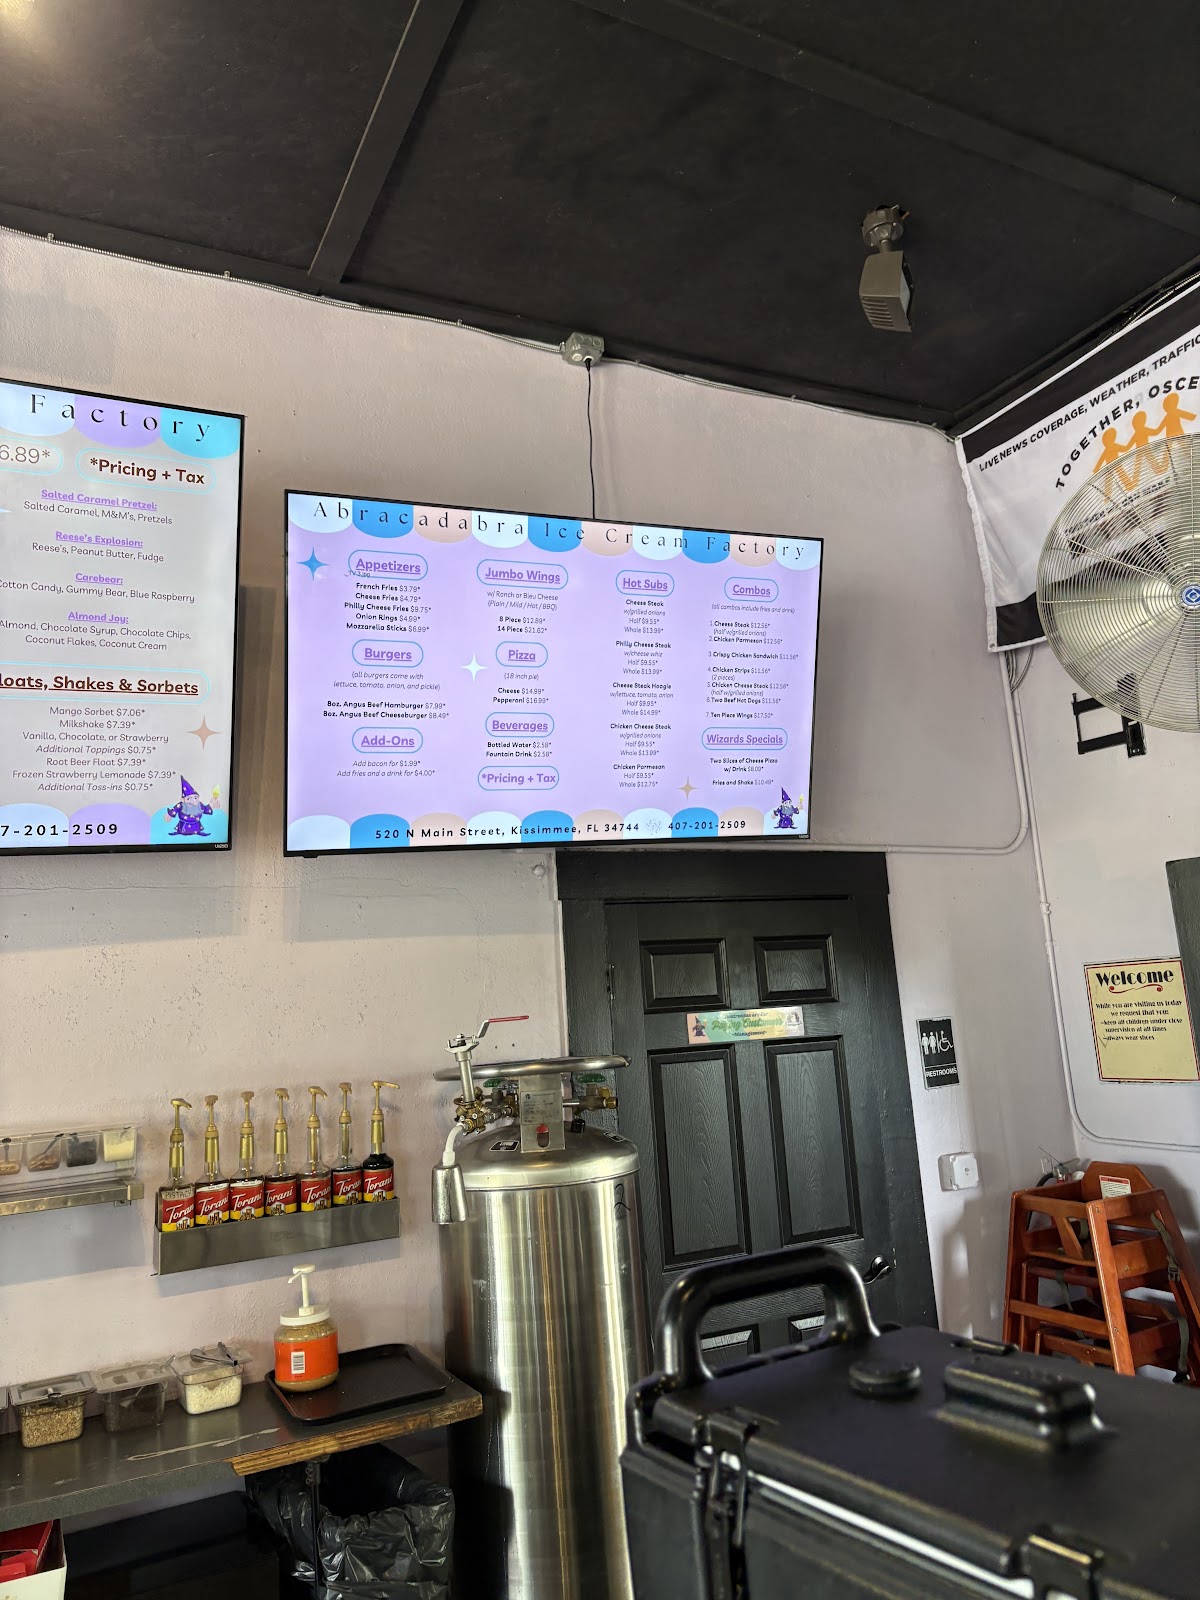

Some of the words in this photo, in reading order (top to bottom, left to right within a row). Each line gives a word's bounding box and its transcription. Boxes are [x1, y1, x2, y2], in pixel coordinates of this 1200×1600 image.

[979, 455, 1000, 472] LIVE
[999, 440, 1028, 461] NEWS
[1030, 404, 1088, 444] COVERAGE,
[1089, 369, 1150, 408] WEATHER,
[1151, 334, 1200, 371] TRAFFIC
[31, 393, 210, 442] Factory
[1055, 398, 1140, 490] TOGETHER,
[1148, 376, 1200, 399] OSCE
[162, 471, 171, 480] +
[176, 468, 205, 485] Tax
[41, 489, 75, 503] Salted
[77, 494, 119, 508] Caramel
[122, 499, 157, 512] Pretzel:
[24, 501, 55, 512] Salted
[57, 505, 100, 518] Caramel,
[101, 510, 136, 522] M&M's,
[138, 514, 173, 525] Pretzels
[314, 501, 523, 535] Abracadabra
[545, 522, 585, 540] Ice
[605, 527, 688, 549] Cream
[706, 536, 804, 559] Factory
[55, 531, 93, 546] Reese's
[95, 535, 143, 549] Explosion:
[32, 542, 69, 554] Reese's,
[71, 546, 104, 557] Peanut
[106, 549, 136, 560] Butter,
[138, 552, 164, 564] Fudge
[355, 558, 421, 575] Appetizers
[75, 573, 123, 586] Carebear:
[485, 567, 523, 581] Jumbo
[526, 569, 561, 584] Wings
[622, 577, 641, 589] Hot
[644, 579, 668, 591] Subs
[0, 579, 29, 590] Cotton
[31, 582, 64, 595] Candy,
[66, 585, 103, 598] Gummy
[105, 588, 128, 598] Bear,
[130, 590, 149, 599] Blue
[151, 591, 195, 604] Raspberry
[732, 584, 771, 597] Combos
[68, 611, 107, 623] Almond
[109, 614, 129, 625] Joy:
[0, 620, 39, 631] Almond,
[41, 622, 88, 633] Chocolate
[90, 625, 118, 637] Syrup,
[120, 627, 164, 638] Chocolate
[166, 630, 192, 640] Chips,
[25, 635, 65, 645] Coconut
[67, 637, 97, 647] Flakes,
[99, 639, 136, 649] Coconut
[138, 641, 167, 650] Cream
[364, 647, 412, 661] Burgers
[508, 649, 536, 662] Pizza
[0, 673, 49, 691] loats,
[53, 676, 114, 693] Shakes
[119, 679, 132, 694] &
[137, 679, 199, 696] Sorbets
[50, 706, 82, 717] Mango
[84, 708, 114, 716] Sorbet
[59, 720, 104, 728] Milkshake
[492, 720, 548, 732] Beverages
[22, 732, 57, 741] Vanilla,
[58, 732, 106, 741] Chocolate,
[119, 734, 169, 744] Strawberry
[360, 735, 415, 748] Add-Ons
[706, 734, 744, 745] Wizards
[746, 734, 783, 745] Specials
[36, 744, 83, 753] Additional
[85, 745, 125, 756] Toppings
[46, 758, 68, 766] Root
[70, 758, 91, 766] Beer
[93, 758, 115, 766] Float
[12, 770, 44, 778] Frozen
[46, 770, 98, 780] Strawberry
[99, 771, 146, 779] Lemonade
[536, 773, 556, 783] Tax
[37, 783, 85, 791] Additional
[87, 783, 123, 791] Toss-ins
[0, 823, 118, 837] 7-201-2509
[375, 829, 399, 839] 520
[406, 829, 414, 838] N
[421, 827, 453, 838] Main
[460, 827, 505, 836] Street,
[511, 825, 581, 835] Kissimmee,
[587, 824, 599, 832] FL
[604, 823, 639, 832] 34744
[668, 820, 746, 830] 407-201-2509
[1095, 970, 1174, 987] Welcome
[925, 1067, 957, 1078] RESTROOMS
[336, 1178, 360, 1197] Toran
[364, 1174, 393, 1194] Torani
[232, 1190, 262, 1212] Torani
[265, 1186, 293, 1206] Torani
[304, 1185, 331, 1204] Toran
[198, 1193, 229, 1217] Torani
[165, 1203, 195, 1225] Toran
